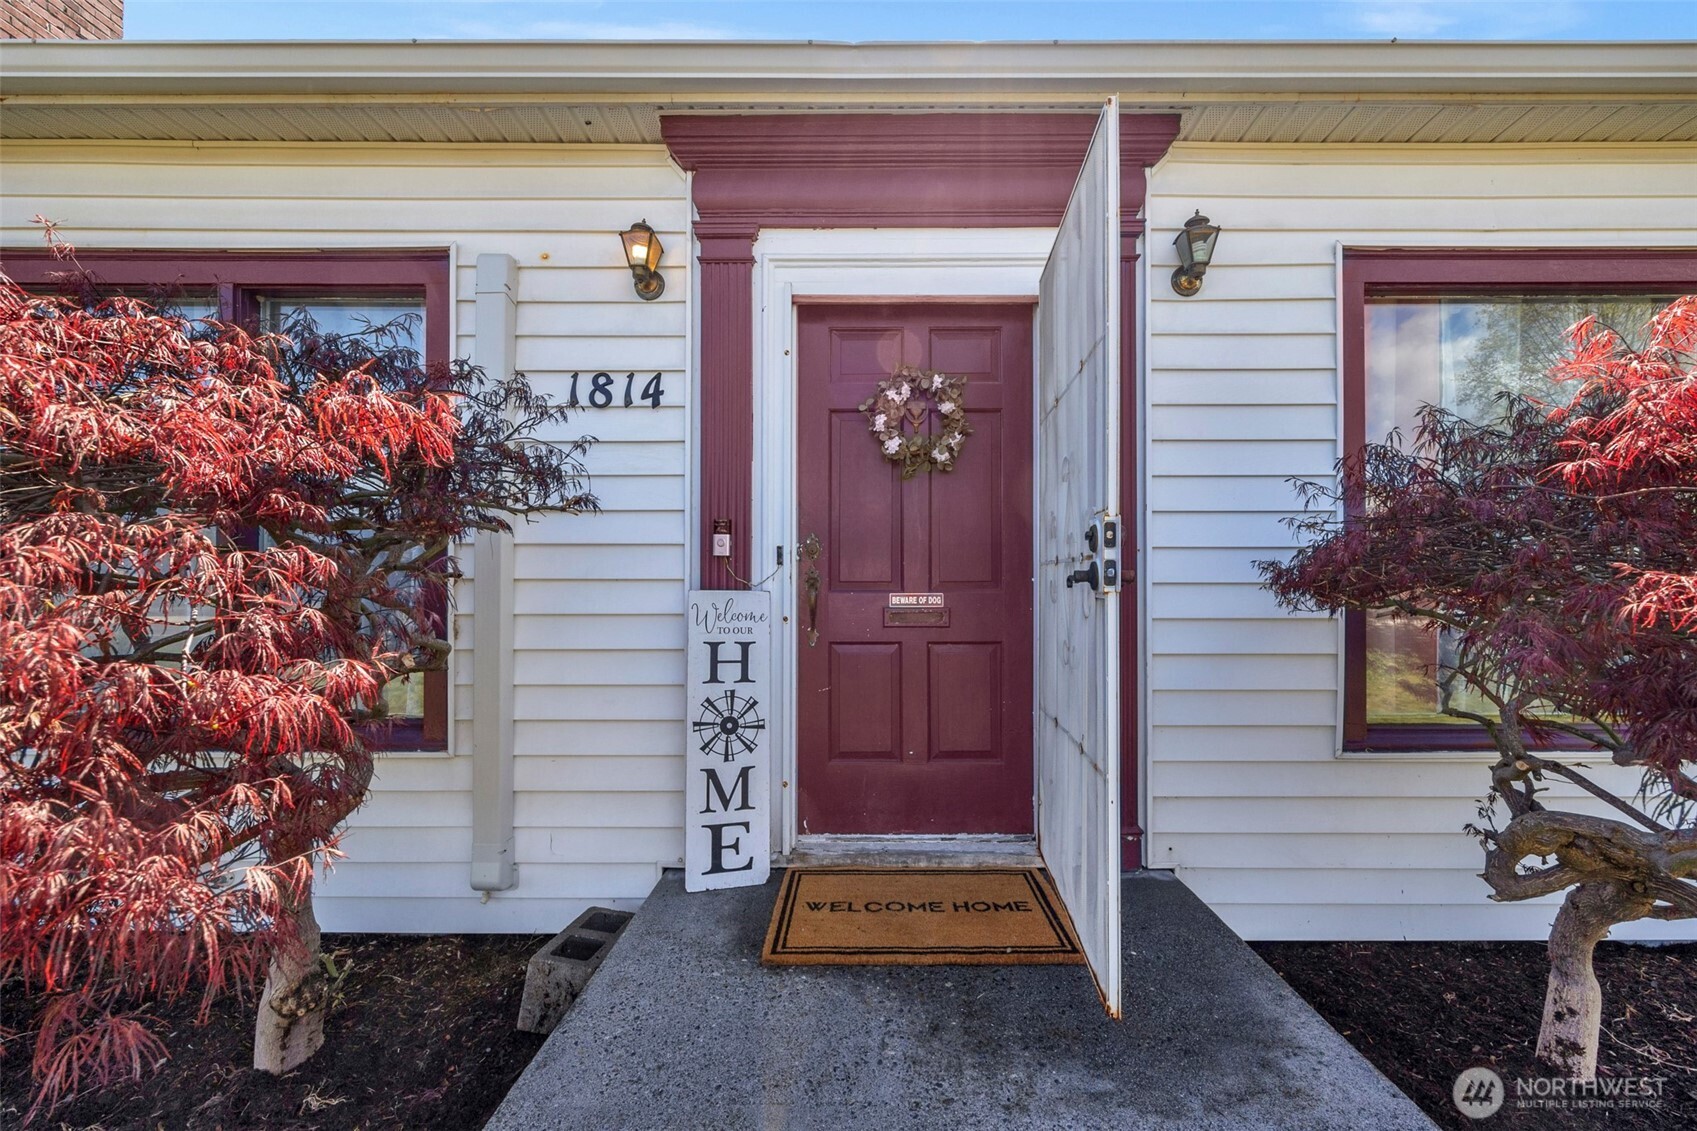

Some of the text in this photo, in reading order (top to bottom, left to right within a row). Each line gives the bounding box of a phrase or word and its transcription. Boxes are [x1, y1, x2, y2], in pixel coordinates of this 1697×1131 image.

[570, 372, 664, 409] 1814
[891, 596, 941, 604] BEWARE OF DOG
[691, 598, 768, 634] Welcome
[717, 626, 753, 634] TO OUR
[805, 901, 1033, 913] WELCOME HOME
